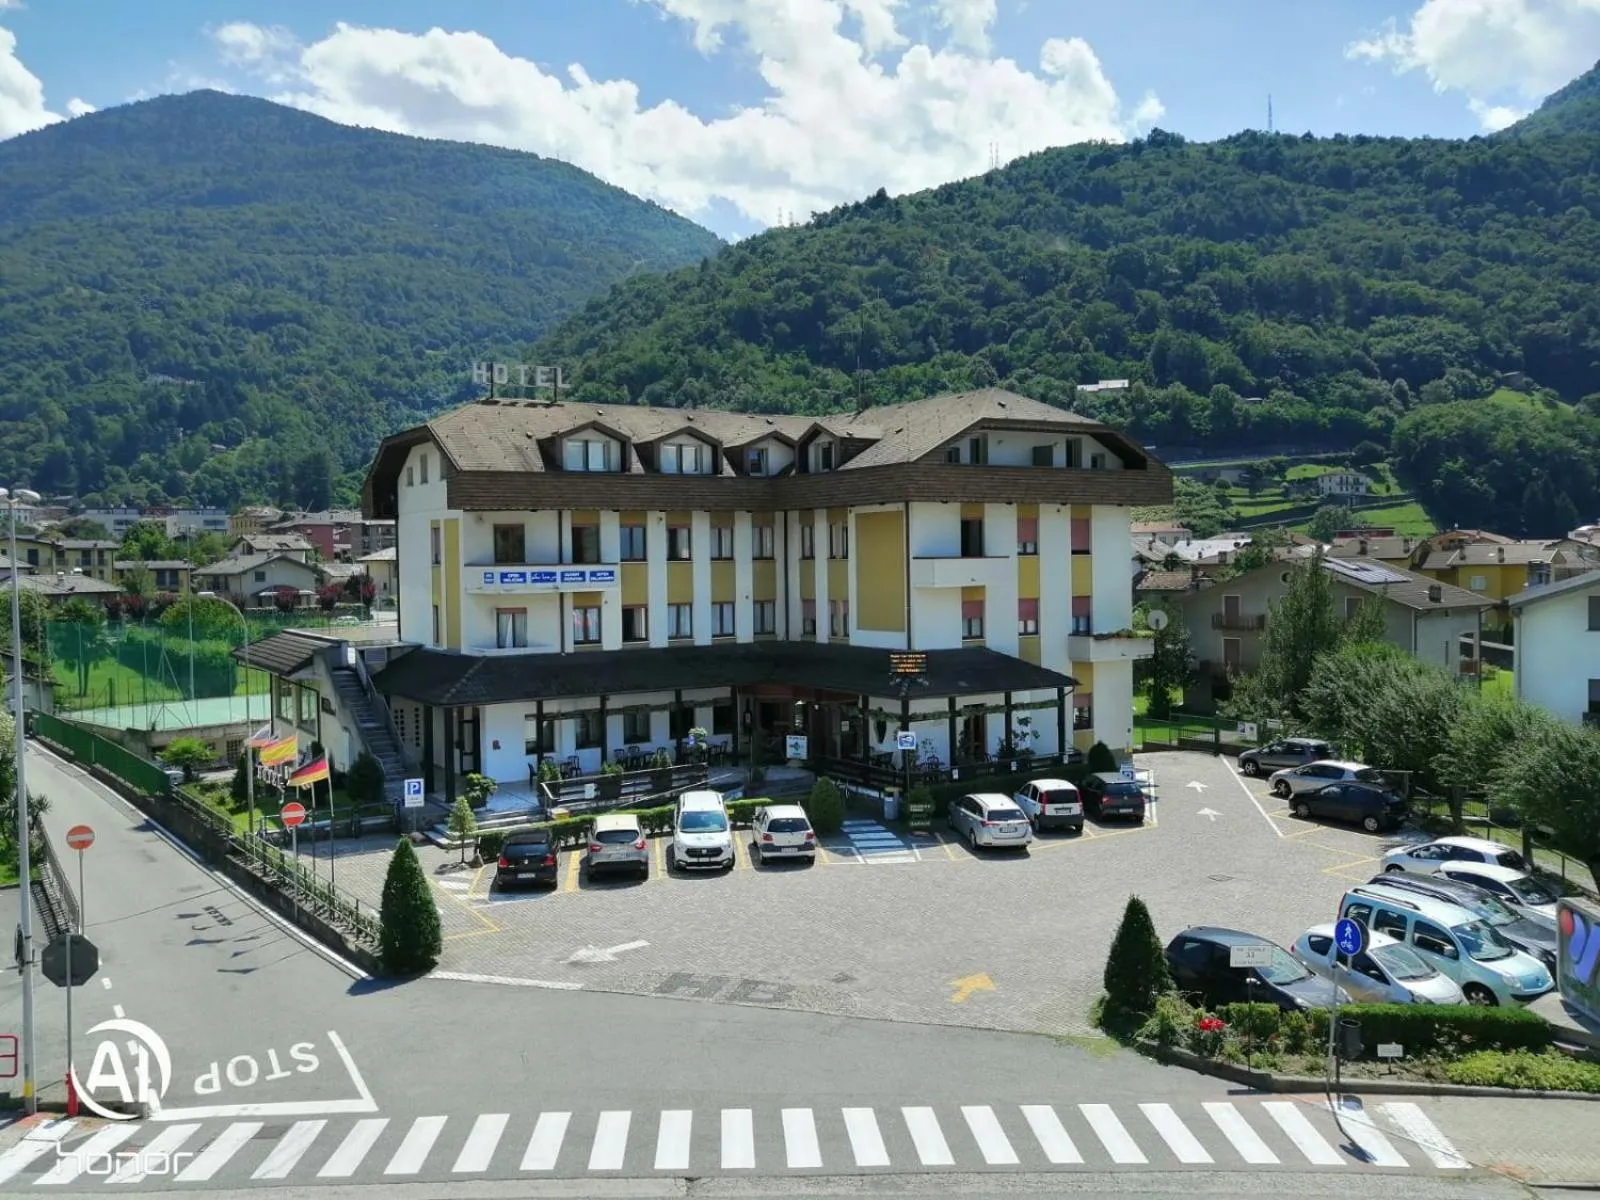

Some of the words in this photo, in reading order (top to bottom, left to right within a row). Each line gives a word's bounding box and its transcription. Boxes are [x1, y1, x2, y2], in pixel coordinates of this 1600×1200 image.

[472, 362, 572, 389] HOTEL
[409, 782, 420, 795] P
[193, 1041, 320, 1095] STOP
